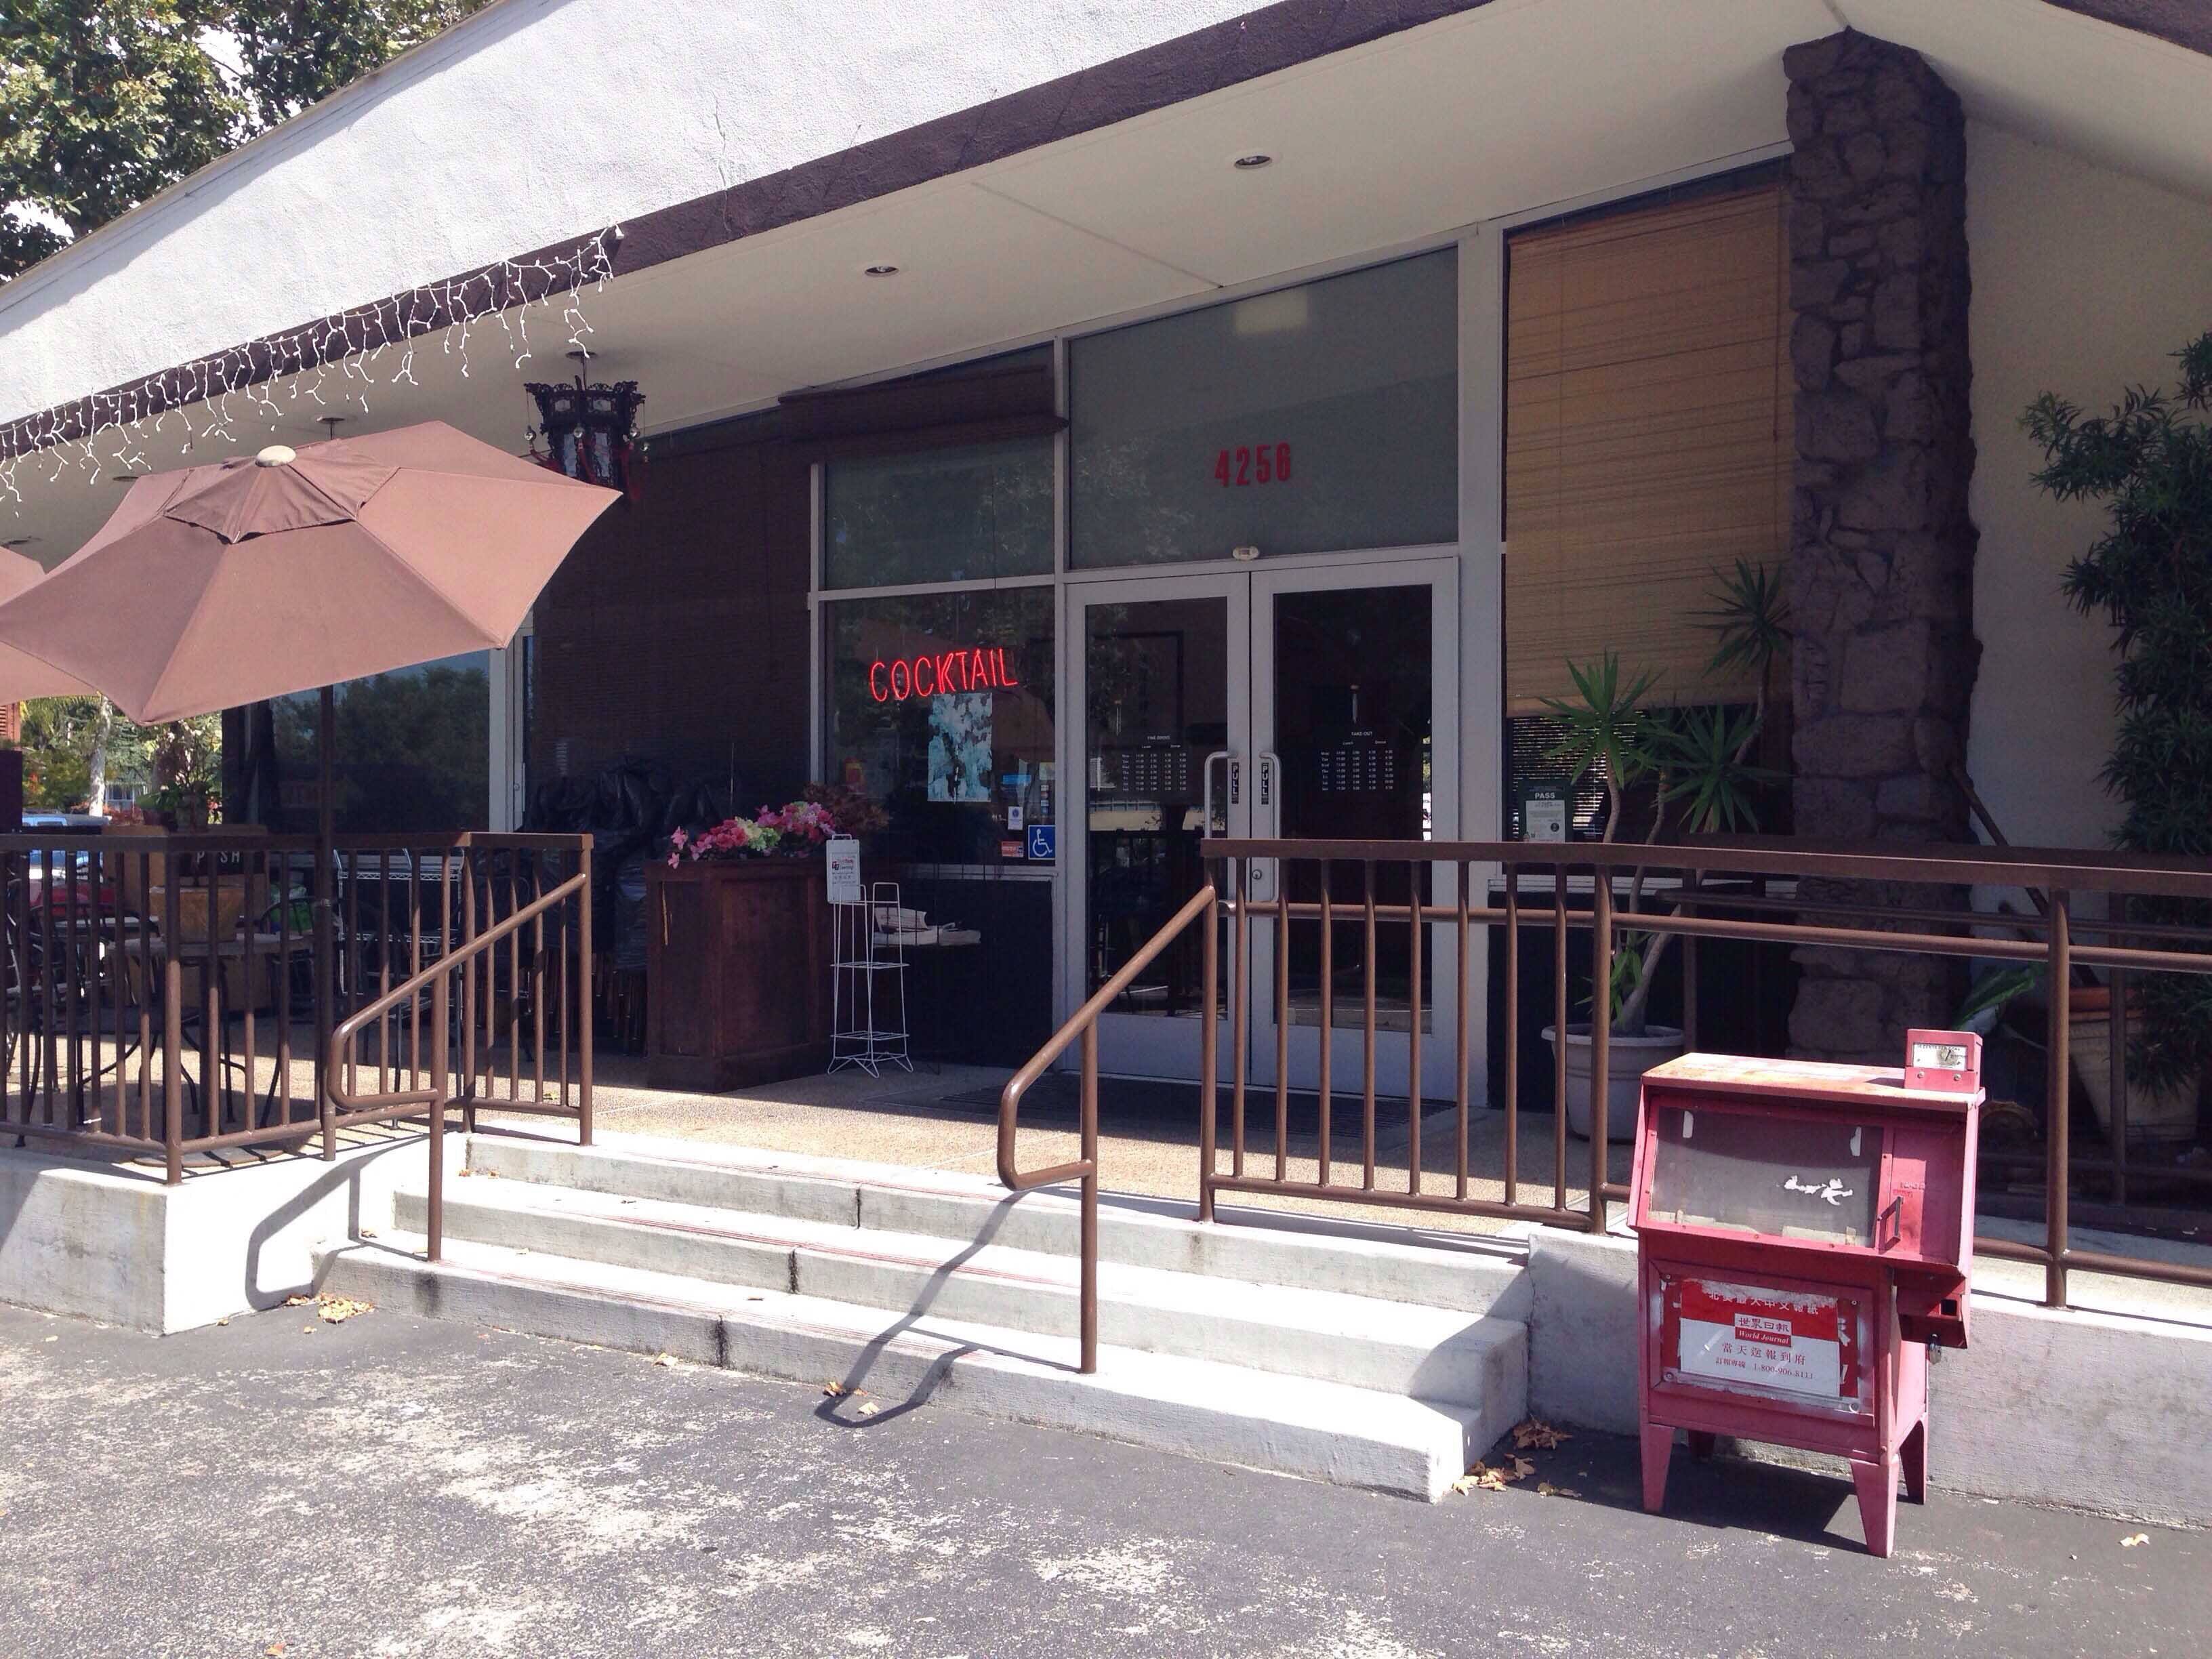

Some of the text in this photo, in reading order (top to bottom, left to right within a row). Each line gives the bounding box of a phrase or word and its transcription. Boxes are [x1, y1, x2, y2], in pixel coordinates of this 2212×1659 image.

[1214, 443, 1291, 487] 4256
[870, 647, 1019, 702] COCKTAIL
[197, 851, 240, 863] PSH
[1739, 1330, 1789, 1345] World Journal
